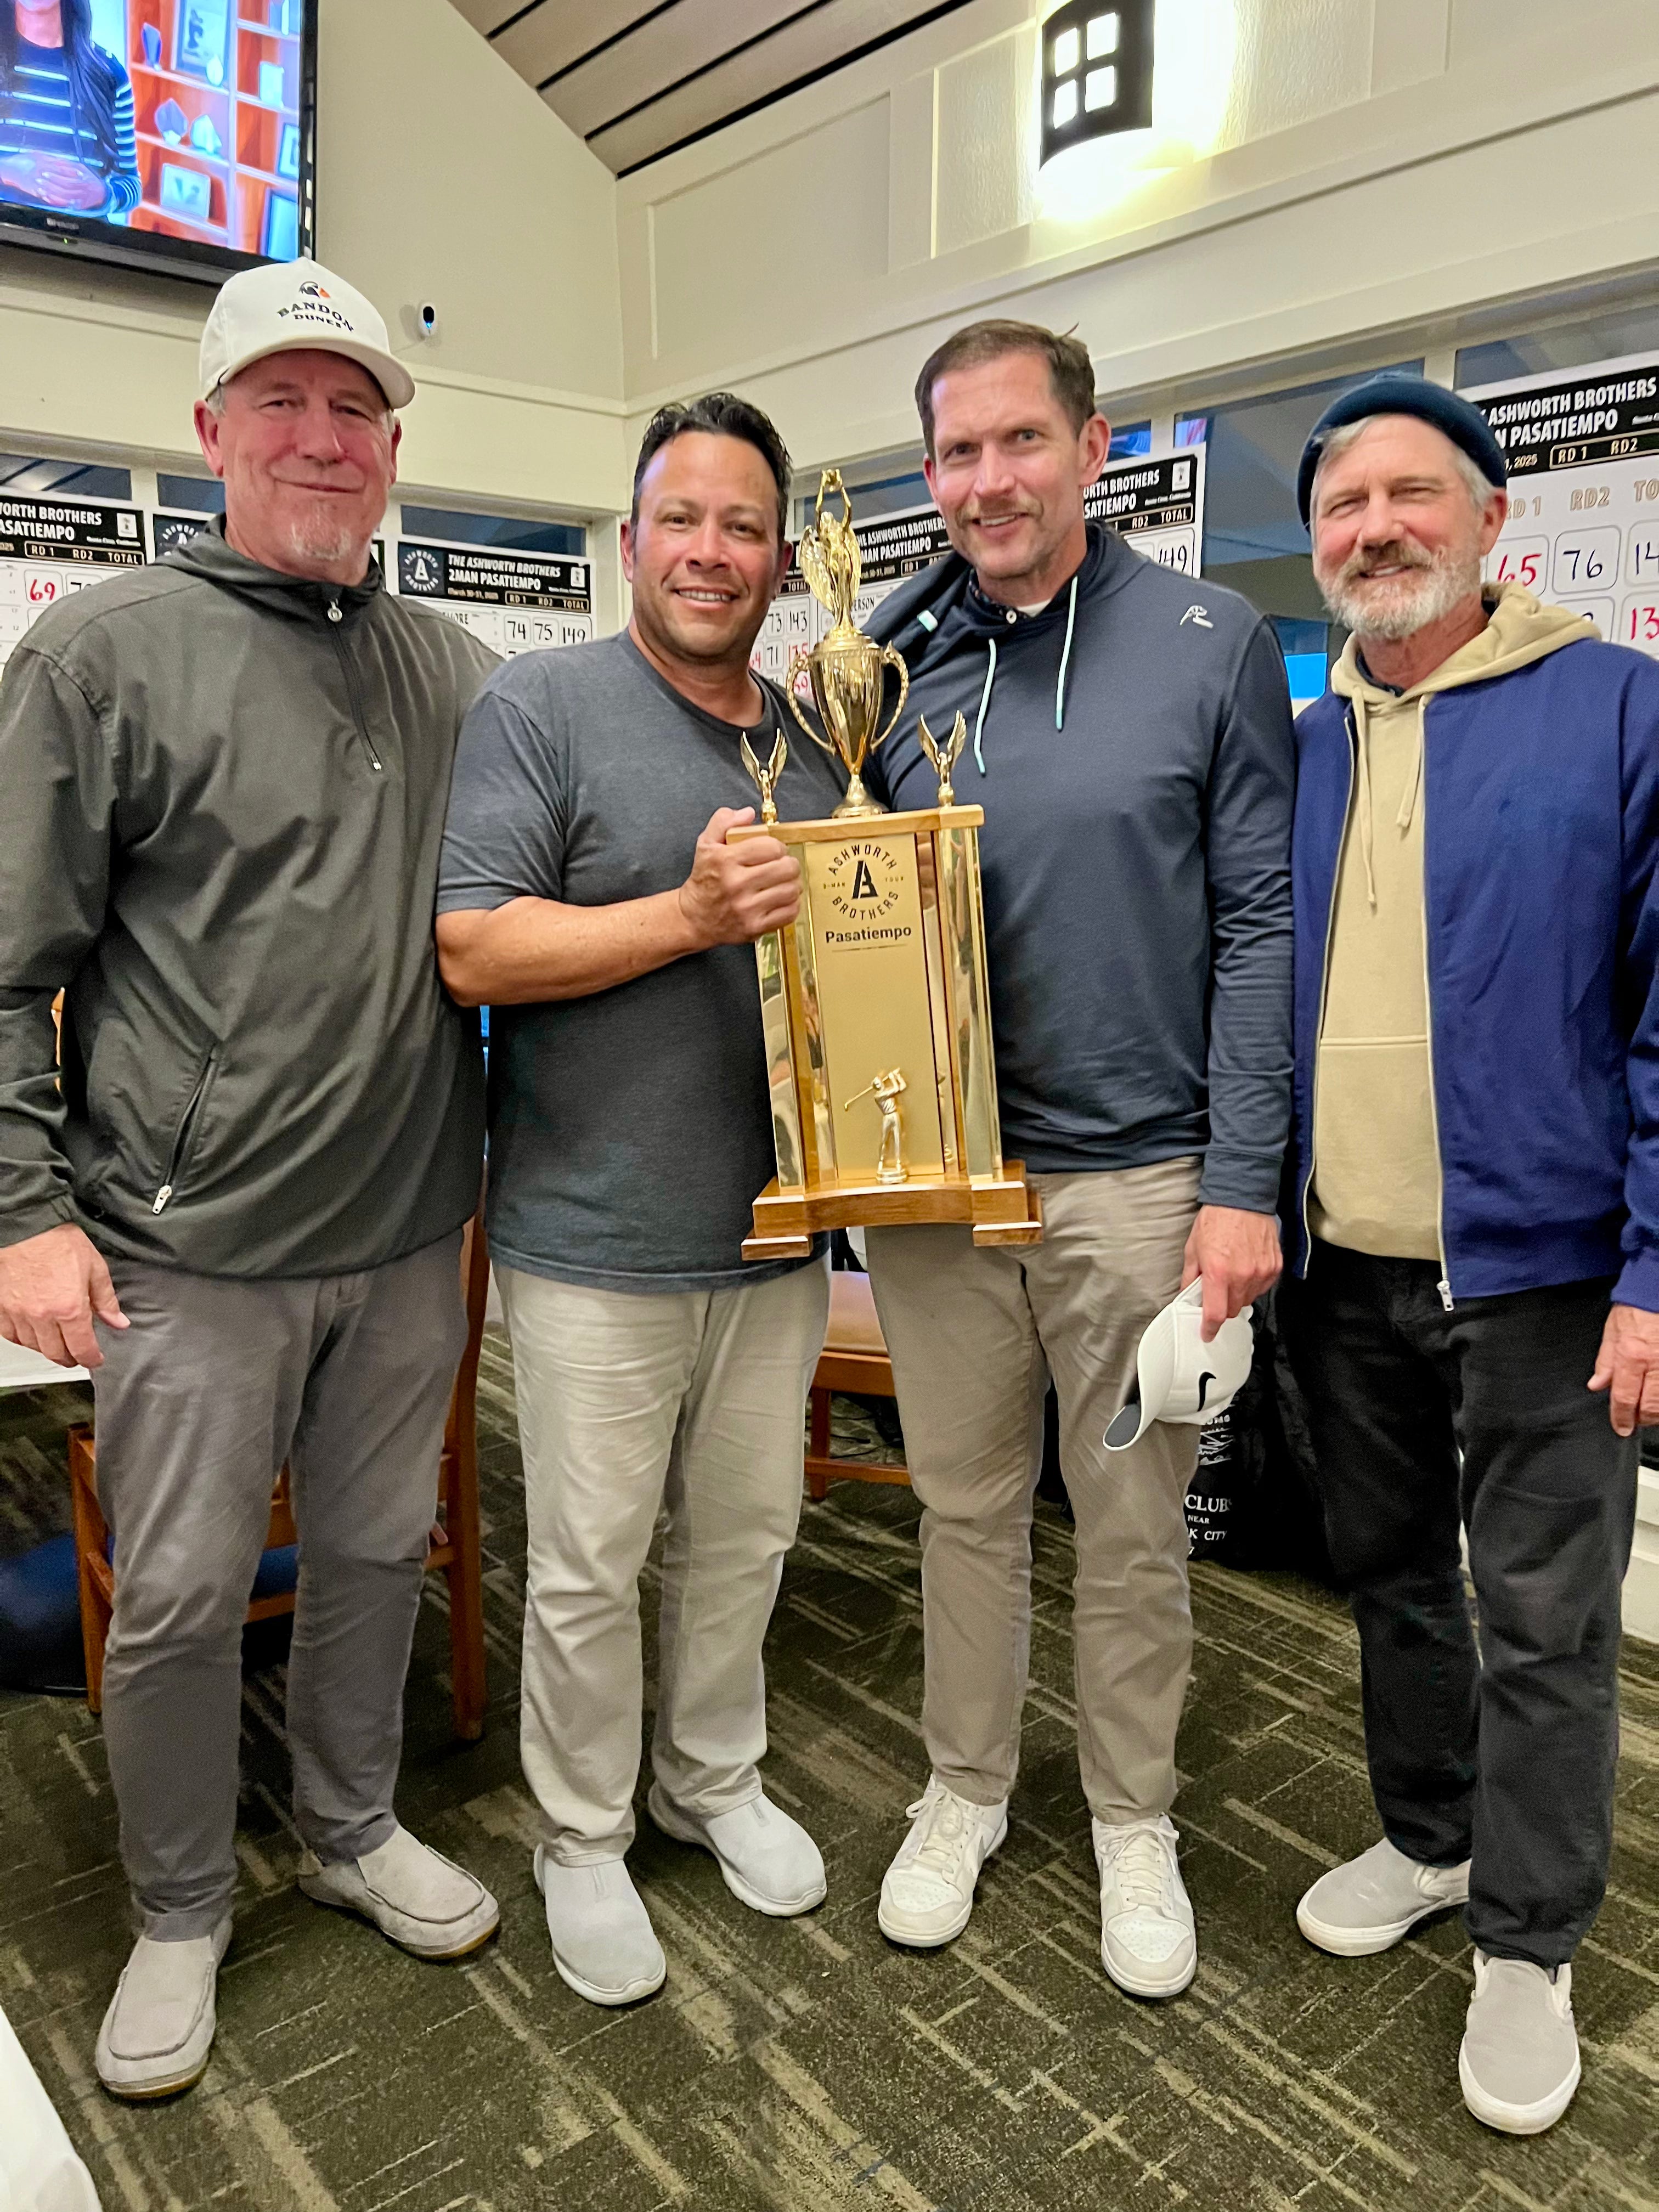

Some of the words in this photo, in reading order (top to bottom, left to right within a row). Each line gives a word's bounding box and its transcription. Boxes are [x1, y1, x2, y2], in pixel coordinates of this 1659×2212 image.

[1488, 392, 1571, 427] ASHWORTH
[1575, 376, 1657, 411] BROTHERS
[1510, 409, 1618, 448] PASATIEMPO
[1558, 448, 1577, 464] RD
[1581, 446, 1588, 460] 1
[1610, 437, 1638, 455] RD2
[1083, 481, 1108, 500] ORTH
[1110, 469, 1160, 494] BROTHERS
[1633, 478, 1659, 503] TO
[1084, 493, 1137, 520] SATIEMPO
[1508, 498, 1526, 519] D
[1570, 486, 1611, 511] RD2
[0, 501, 36, 519] ORTH
[39, 506, 102, 525] BROTHERS
[1132, 516, 1149, 529] RD2
[1161, 508, 1187, 524] TOTAL
[0, 518, 75, 541] ASATIEMPO
[867, 524, 908, 545] ASHWORTH
[32, 545, 46, 556] RD
[72, 549, 93, 560] RD2
[108, 552, 138, 564] TOTAL
[861, 546, 879, 565] MAN
[880, 536, 932, 561] PASATIEMPO
[1636, 541, 1659, 575] 14
[448, 554, 466, 567] THE
[466, 556, 516, 573] ASHWORTH
[517, 562, 561, 577] BROTHERS
[1563, 549, 1603, 581] 76
[30, 579, 55, 601] 69
[448, 568, 479, 584] 2MAN
[481, 572, 541, 590] PASATIEMPO
[563, 599, 584, 610] TOTAL
[507, 620, 526, 640] 74
[534, 623, 553, 640] 75
[789, 610, 808, 632] 143
[1630, 607, 1659, 641] 13
[563, 627, 585, 644] 149
[767, 646, 778, 666] 71
[828, 844, 897, 876] ASHWORTH
[832, 891, 899, 920] BROTHERS
[826, 926, 911, 944] Pasatiempo
[1187, 1514, 1210, 1524] NEAR
[1204, 1531, 1228, 1541] CITY
